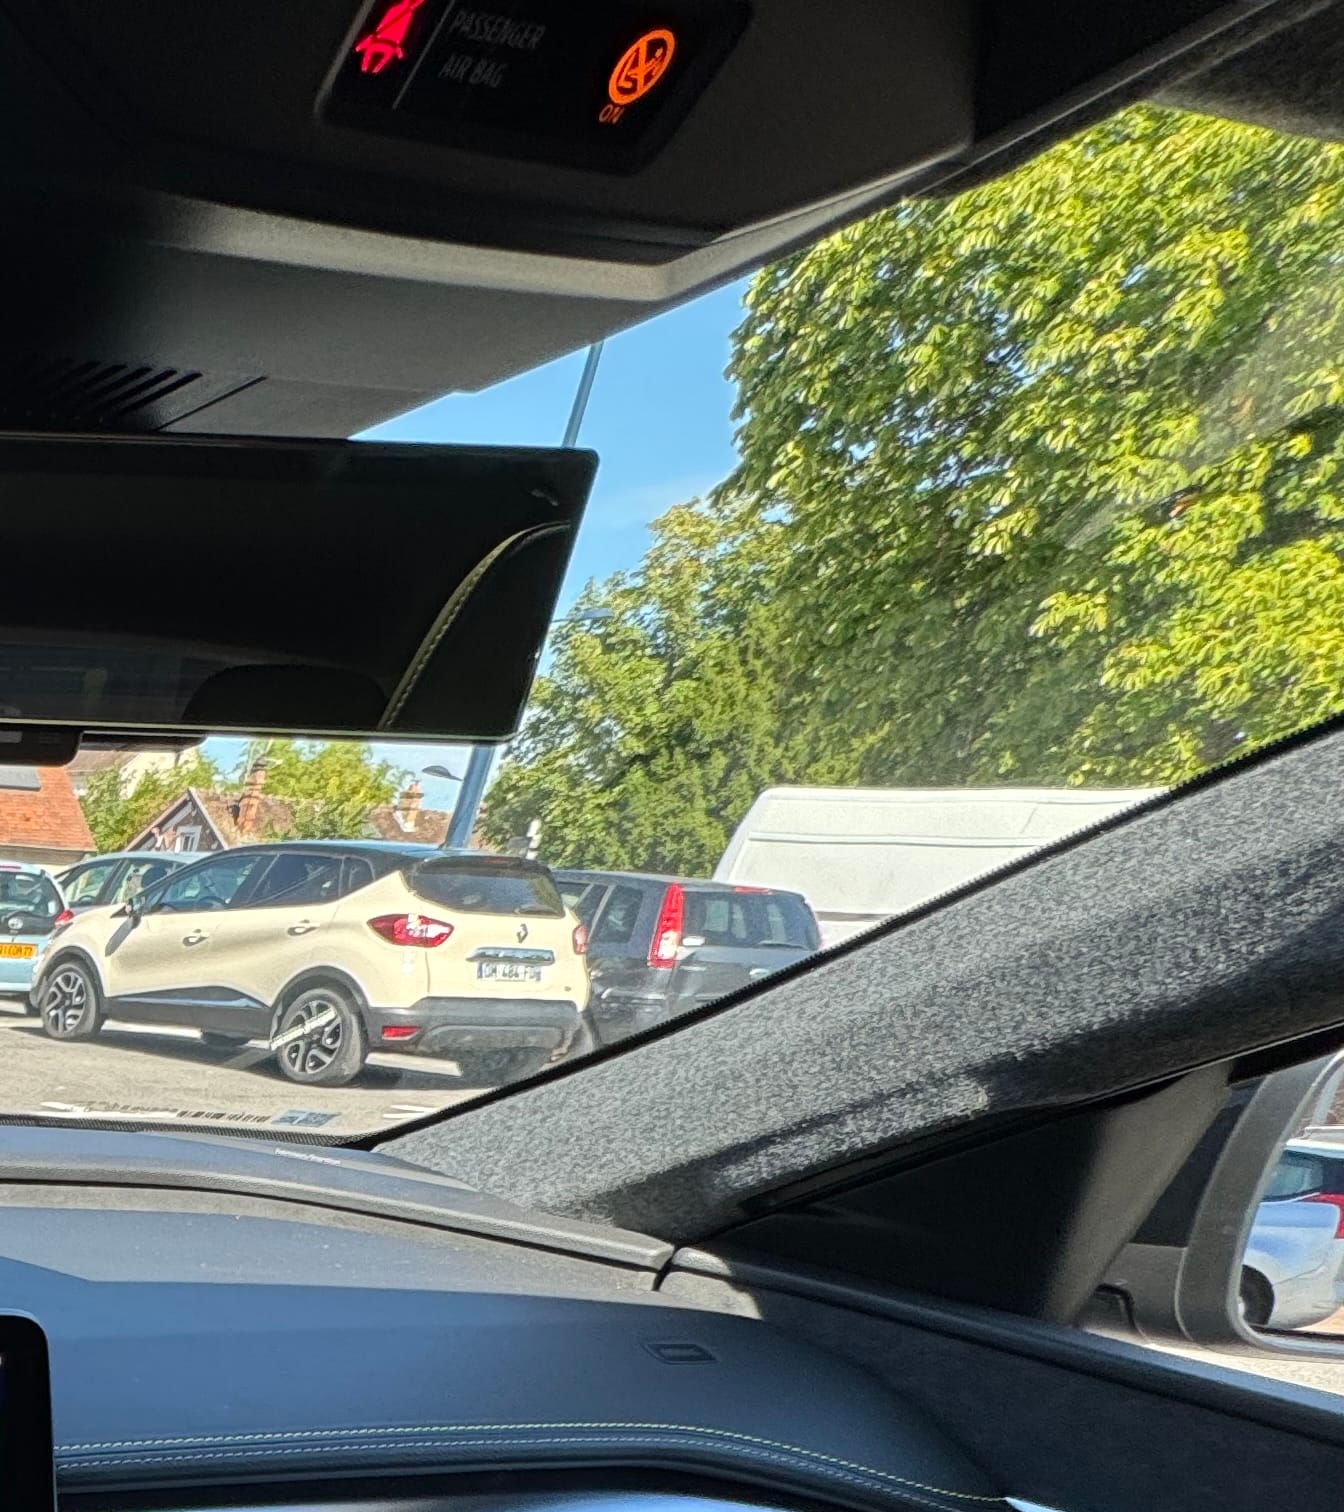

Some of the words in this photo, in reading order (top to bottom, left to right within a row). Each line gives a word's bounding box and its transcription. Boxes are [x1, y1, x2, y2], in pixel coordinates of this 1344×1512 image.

[447, 9, 547, 49] PASSENGER
[437, 53, 473, 82] AIR
[469, 58, 510, 88] BAG
